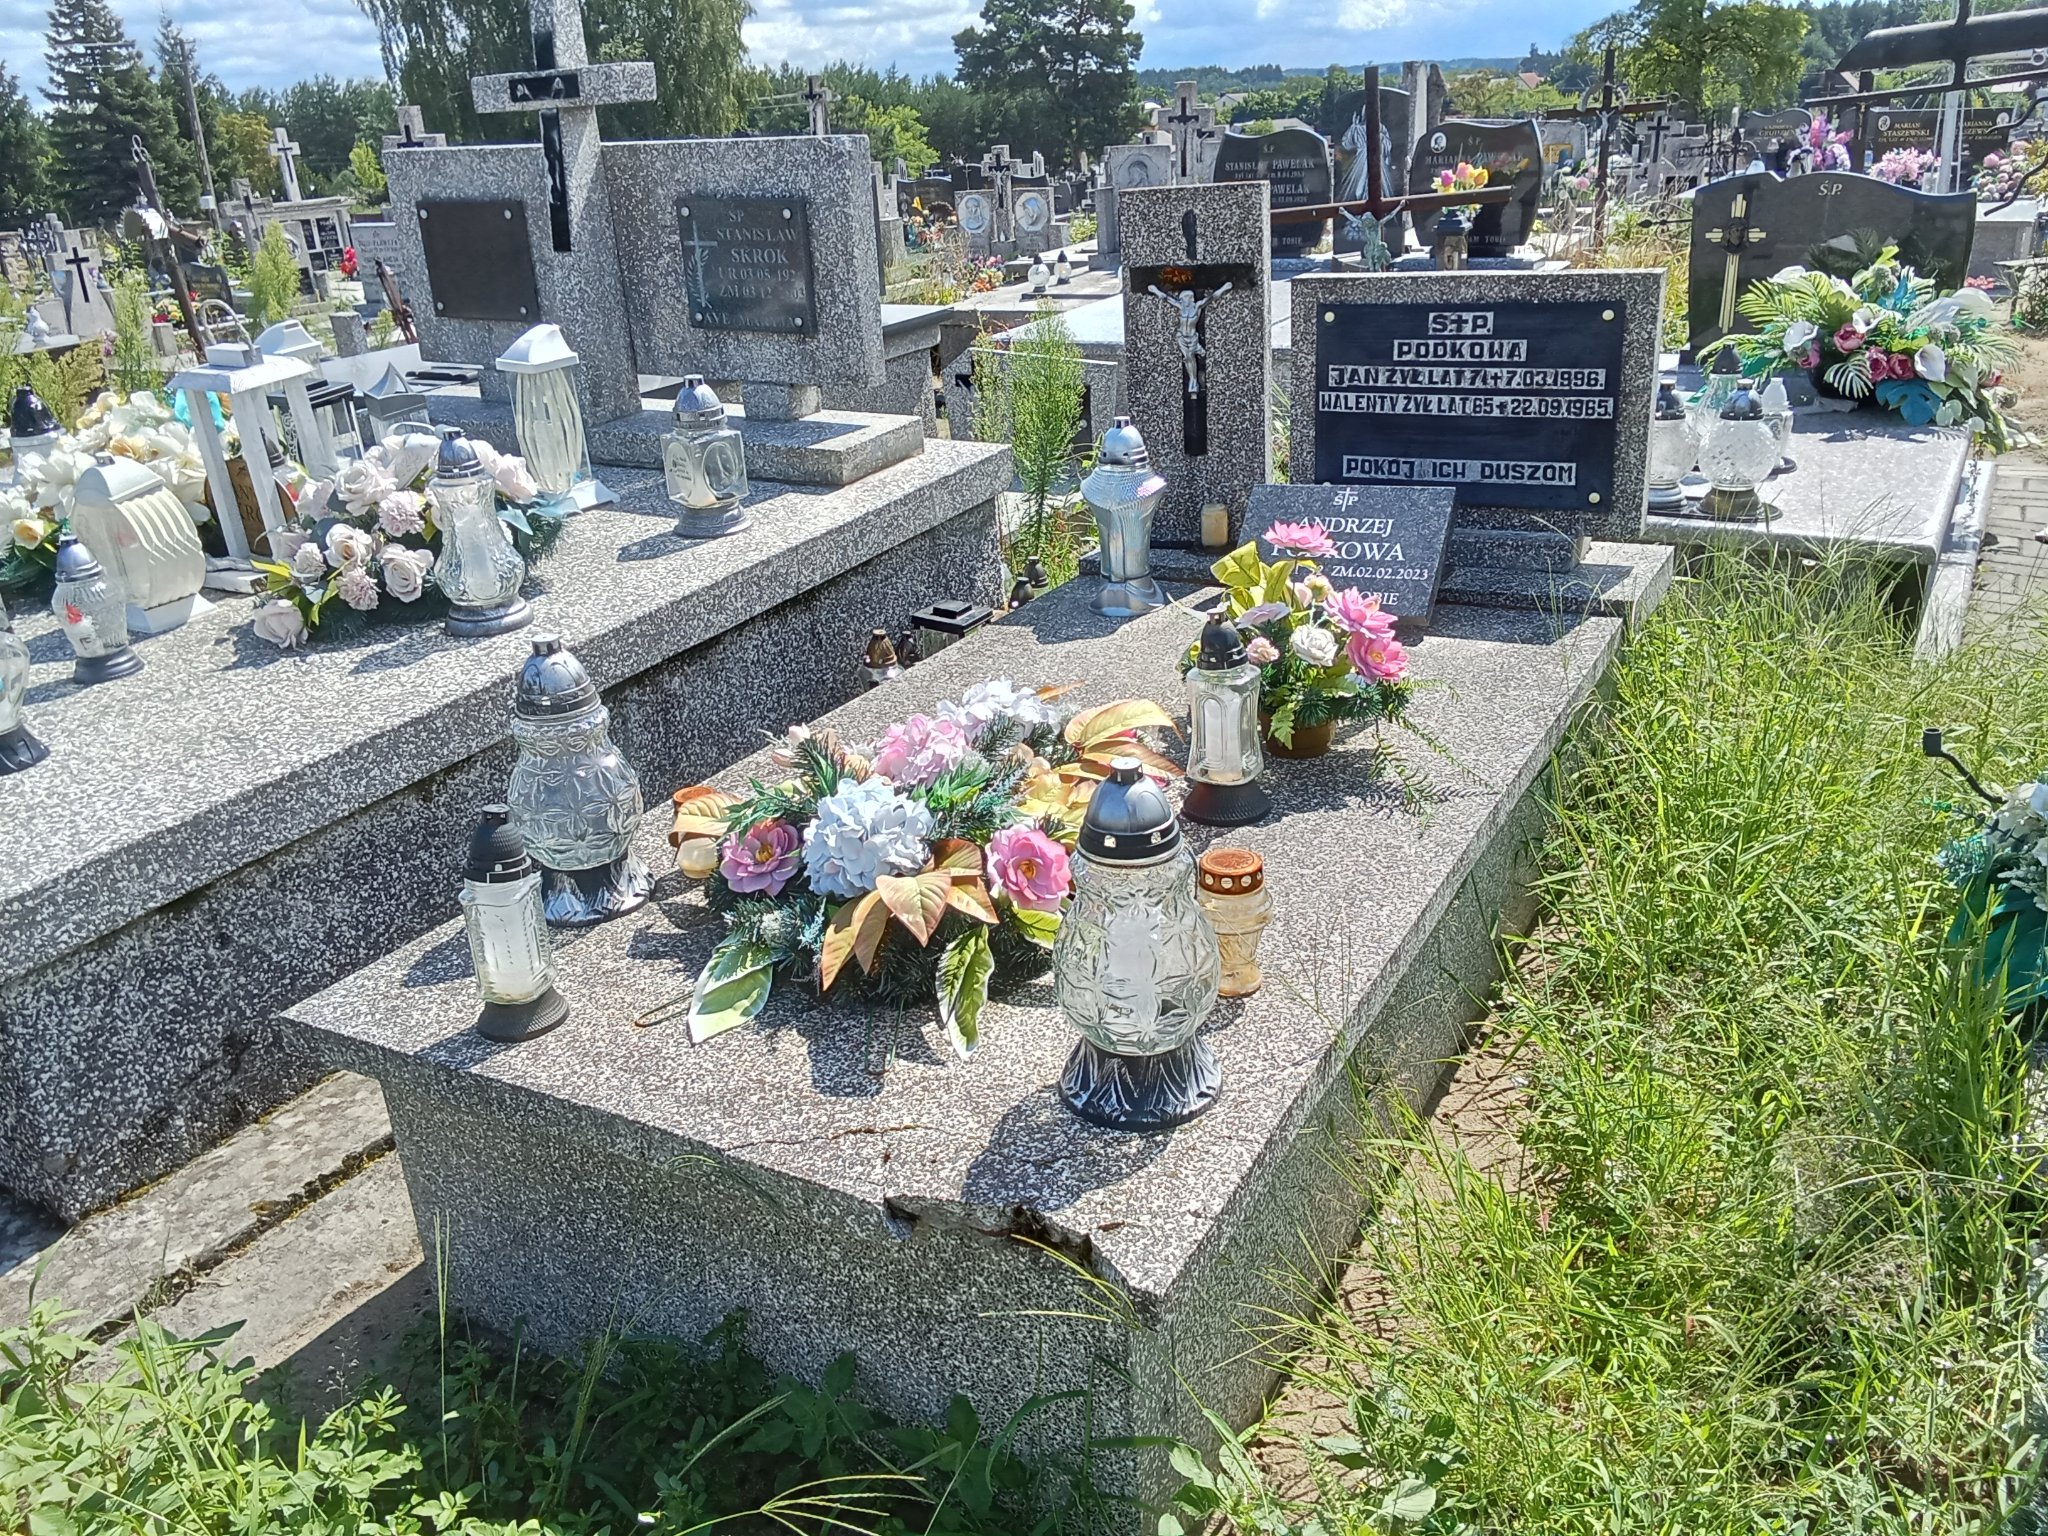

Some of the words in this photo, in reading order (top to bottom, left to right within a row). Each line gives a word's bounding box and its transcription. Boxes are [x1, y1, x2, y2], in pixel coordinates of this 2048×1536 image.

[1397, 341, 1522, 360] PODKOWA
[1331, 367, 1379, 386] JAN
[1321, 393, 1398, 411] WALENTY
[1431, 460, 1467, 479] ICH
[1480, 462, 1574, 483] DUSZOM
[1271, 541, 1406, 562] KOWA
